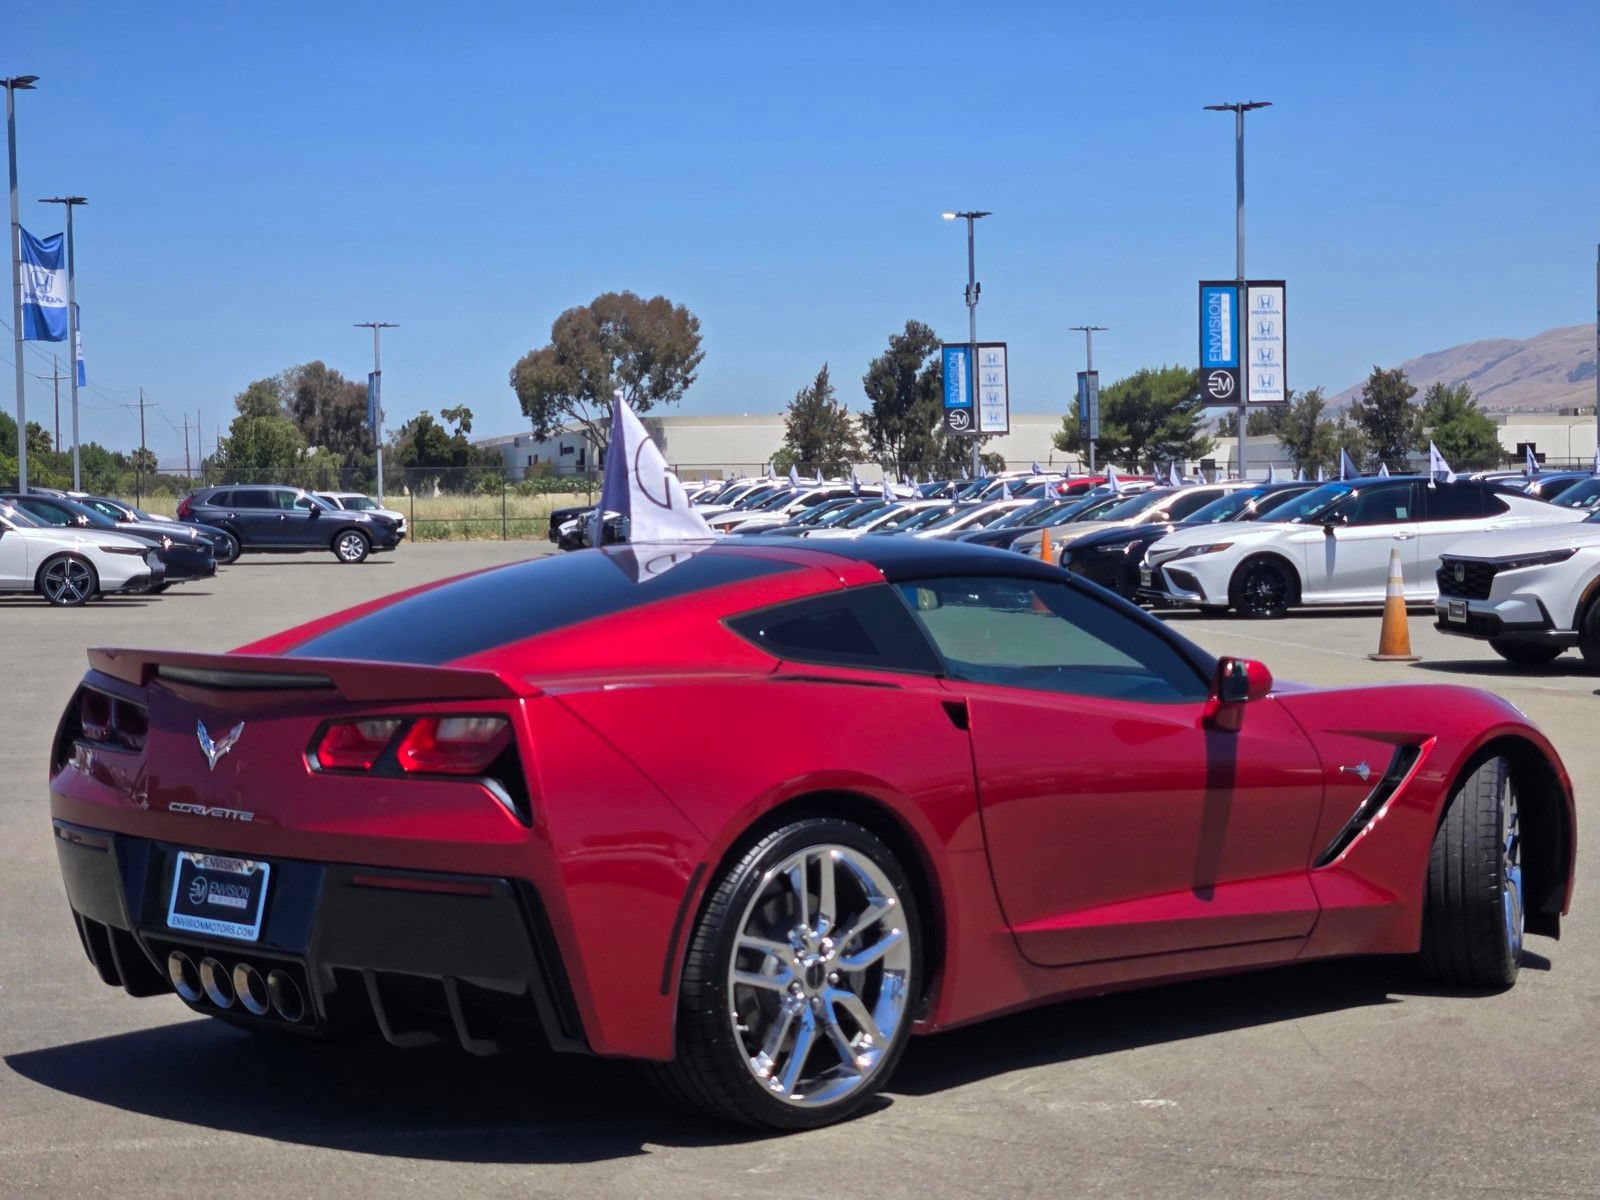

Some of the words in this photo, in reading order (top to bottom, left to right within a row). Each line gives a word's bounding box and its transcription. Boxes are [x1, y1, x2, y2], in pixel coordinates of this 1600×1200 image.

[1208, 293, 1221, 361] ENVISION
[949, 352, 958, 404] ENVISION
[168, 802, 255, 821] CORVETTE
[203, 855, 243, 872] ENVISION
[209, 882, 250, 899] ENVISION
[171, 916, 255, 938] ENVISIONMOTORS.COM
